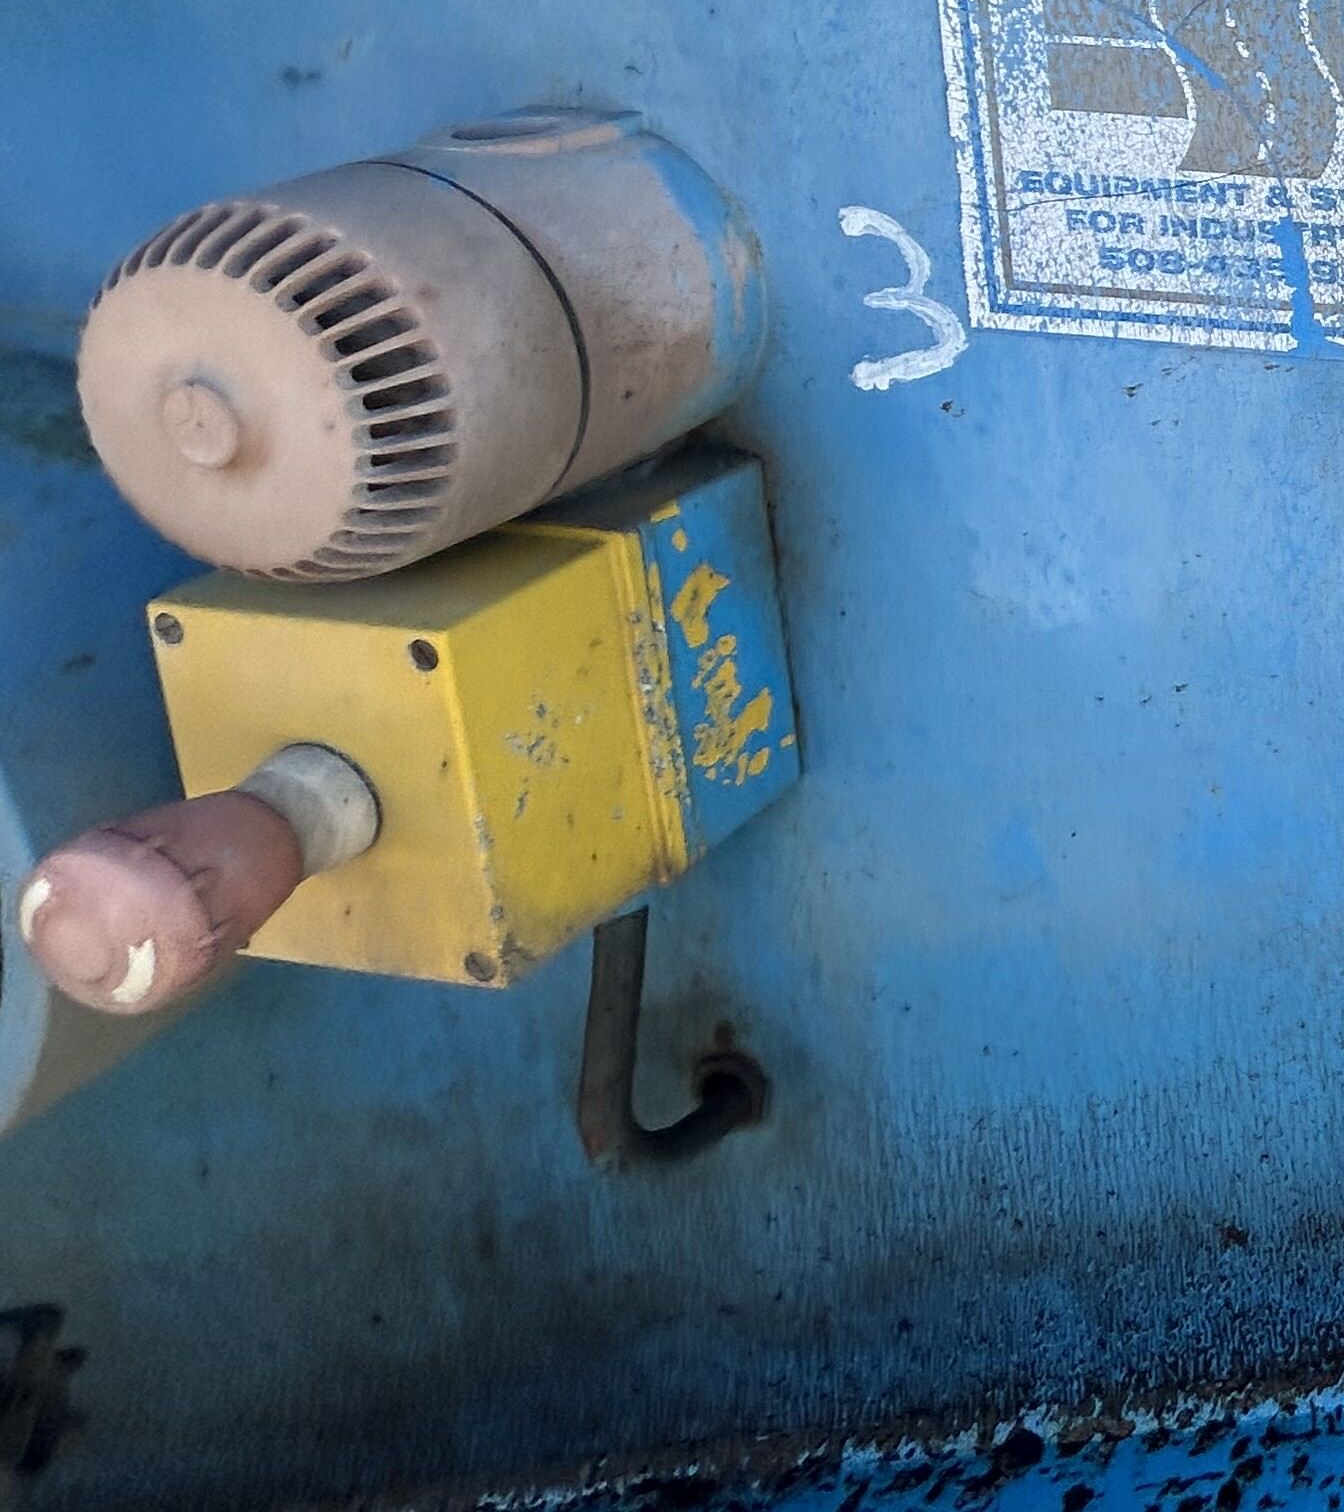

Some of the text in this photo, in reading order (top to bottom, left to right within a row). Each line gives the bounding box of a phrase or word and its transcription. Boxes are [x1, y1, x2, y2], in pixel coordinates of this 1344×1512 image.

[1016, 169, 1251, 206] EQUIPMENT
[1065, 208, 1145, 236] FOR
[837, 205, 970, 391] 3
